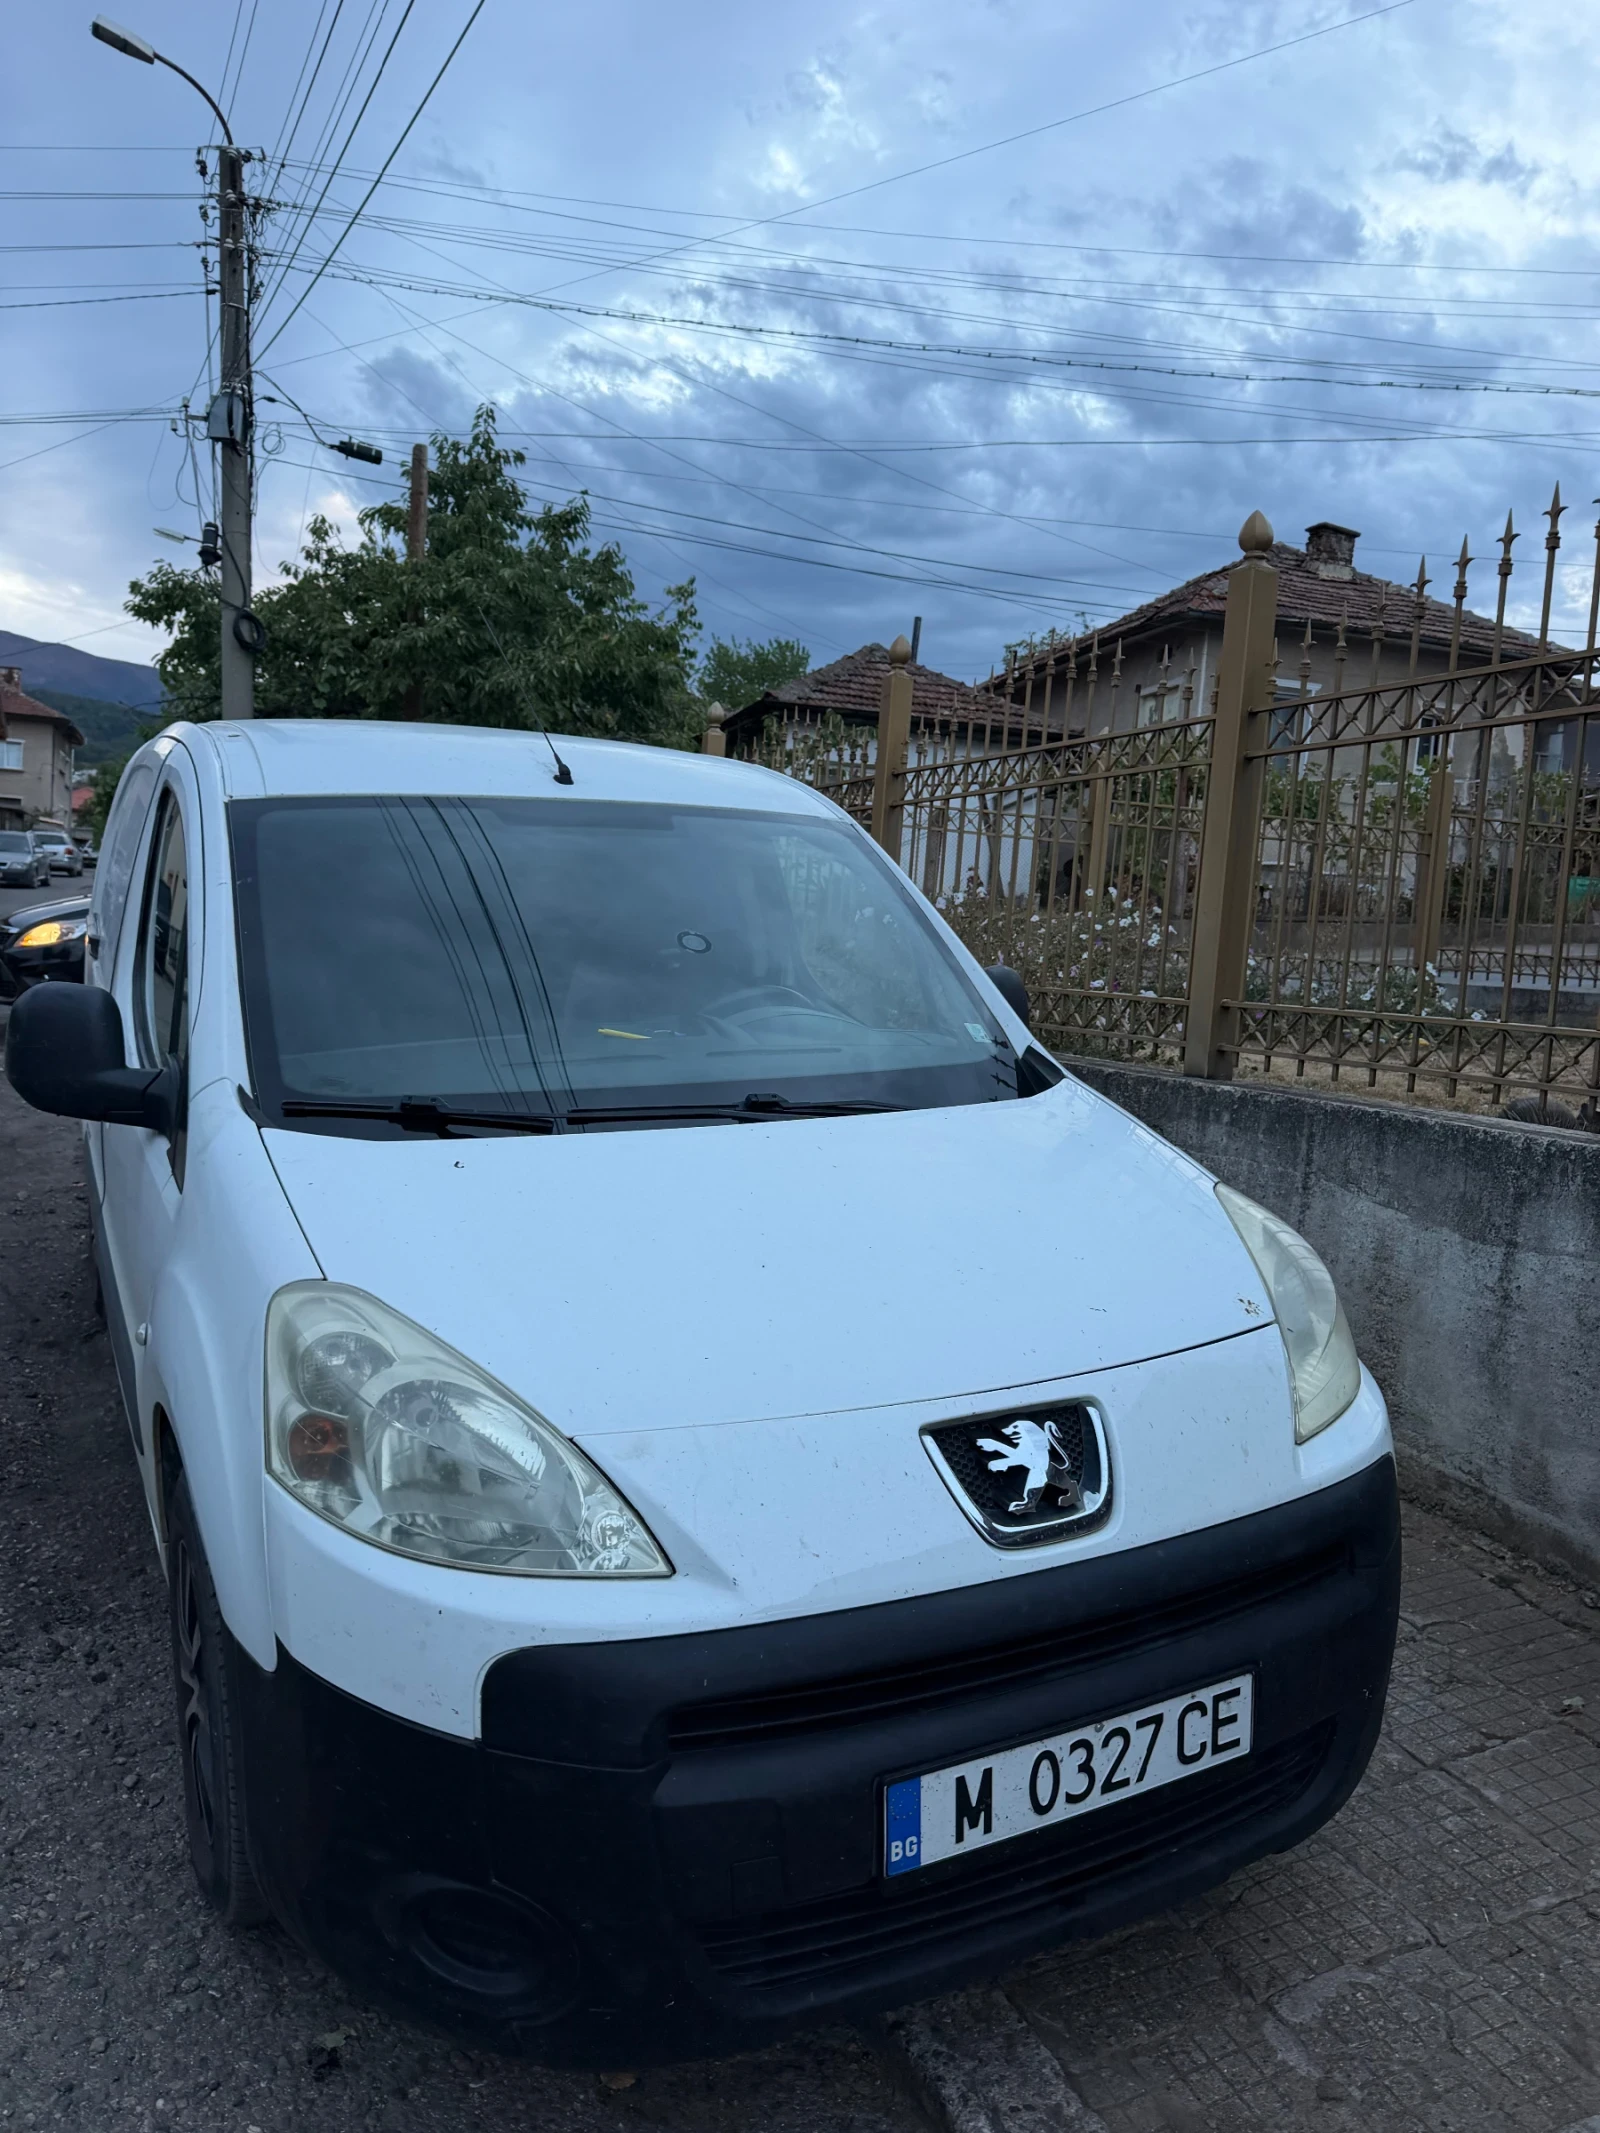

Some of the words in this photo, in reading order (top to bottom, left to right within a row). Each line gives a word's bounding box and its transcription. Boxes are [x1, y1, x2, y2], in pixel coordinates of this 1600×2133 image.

[954, 1767, 993, 1844] M
[1028, 1713, 1164, 1816] 0327
[1177, 1687, 1241, 1765] CE
[890, 1836, 918, 1862] BG
